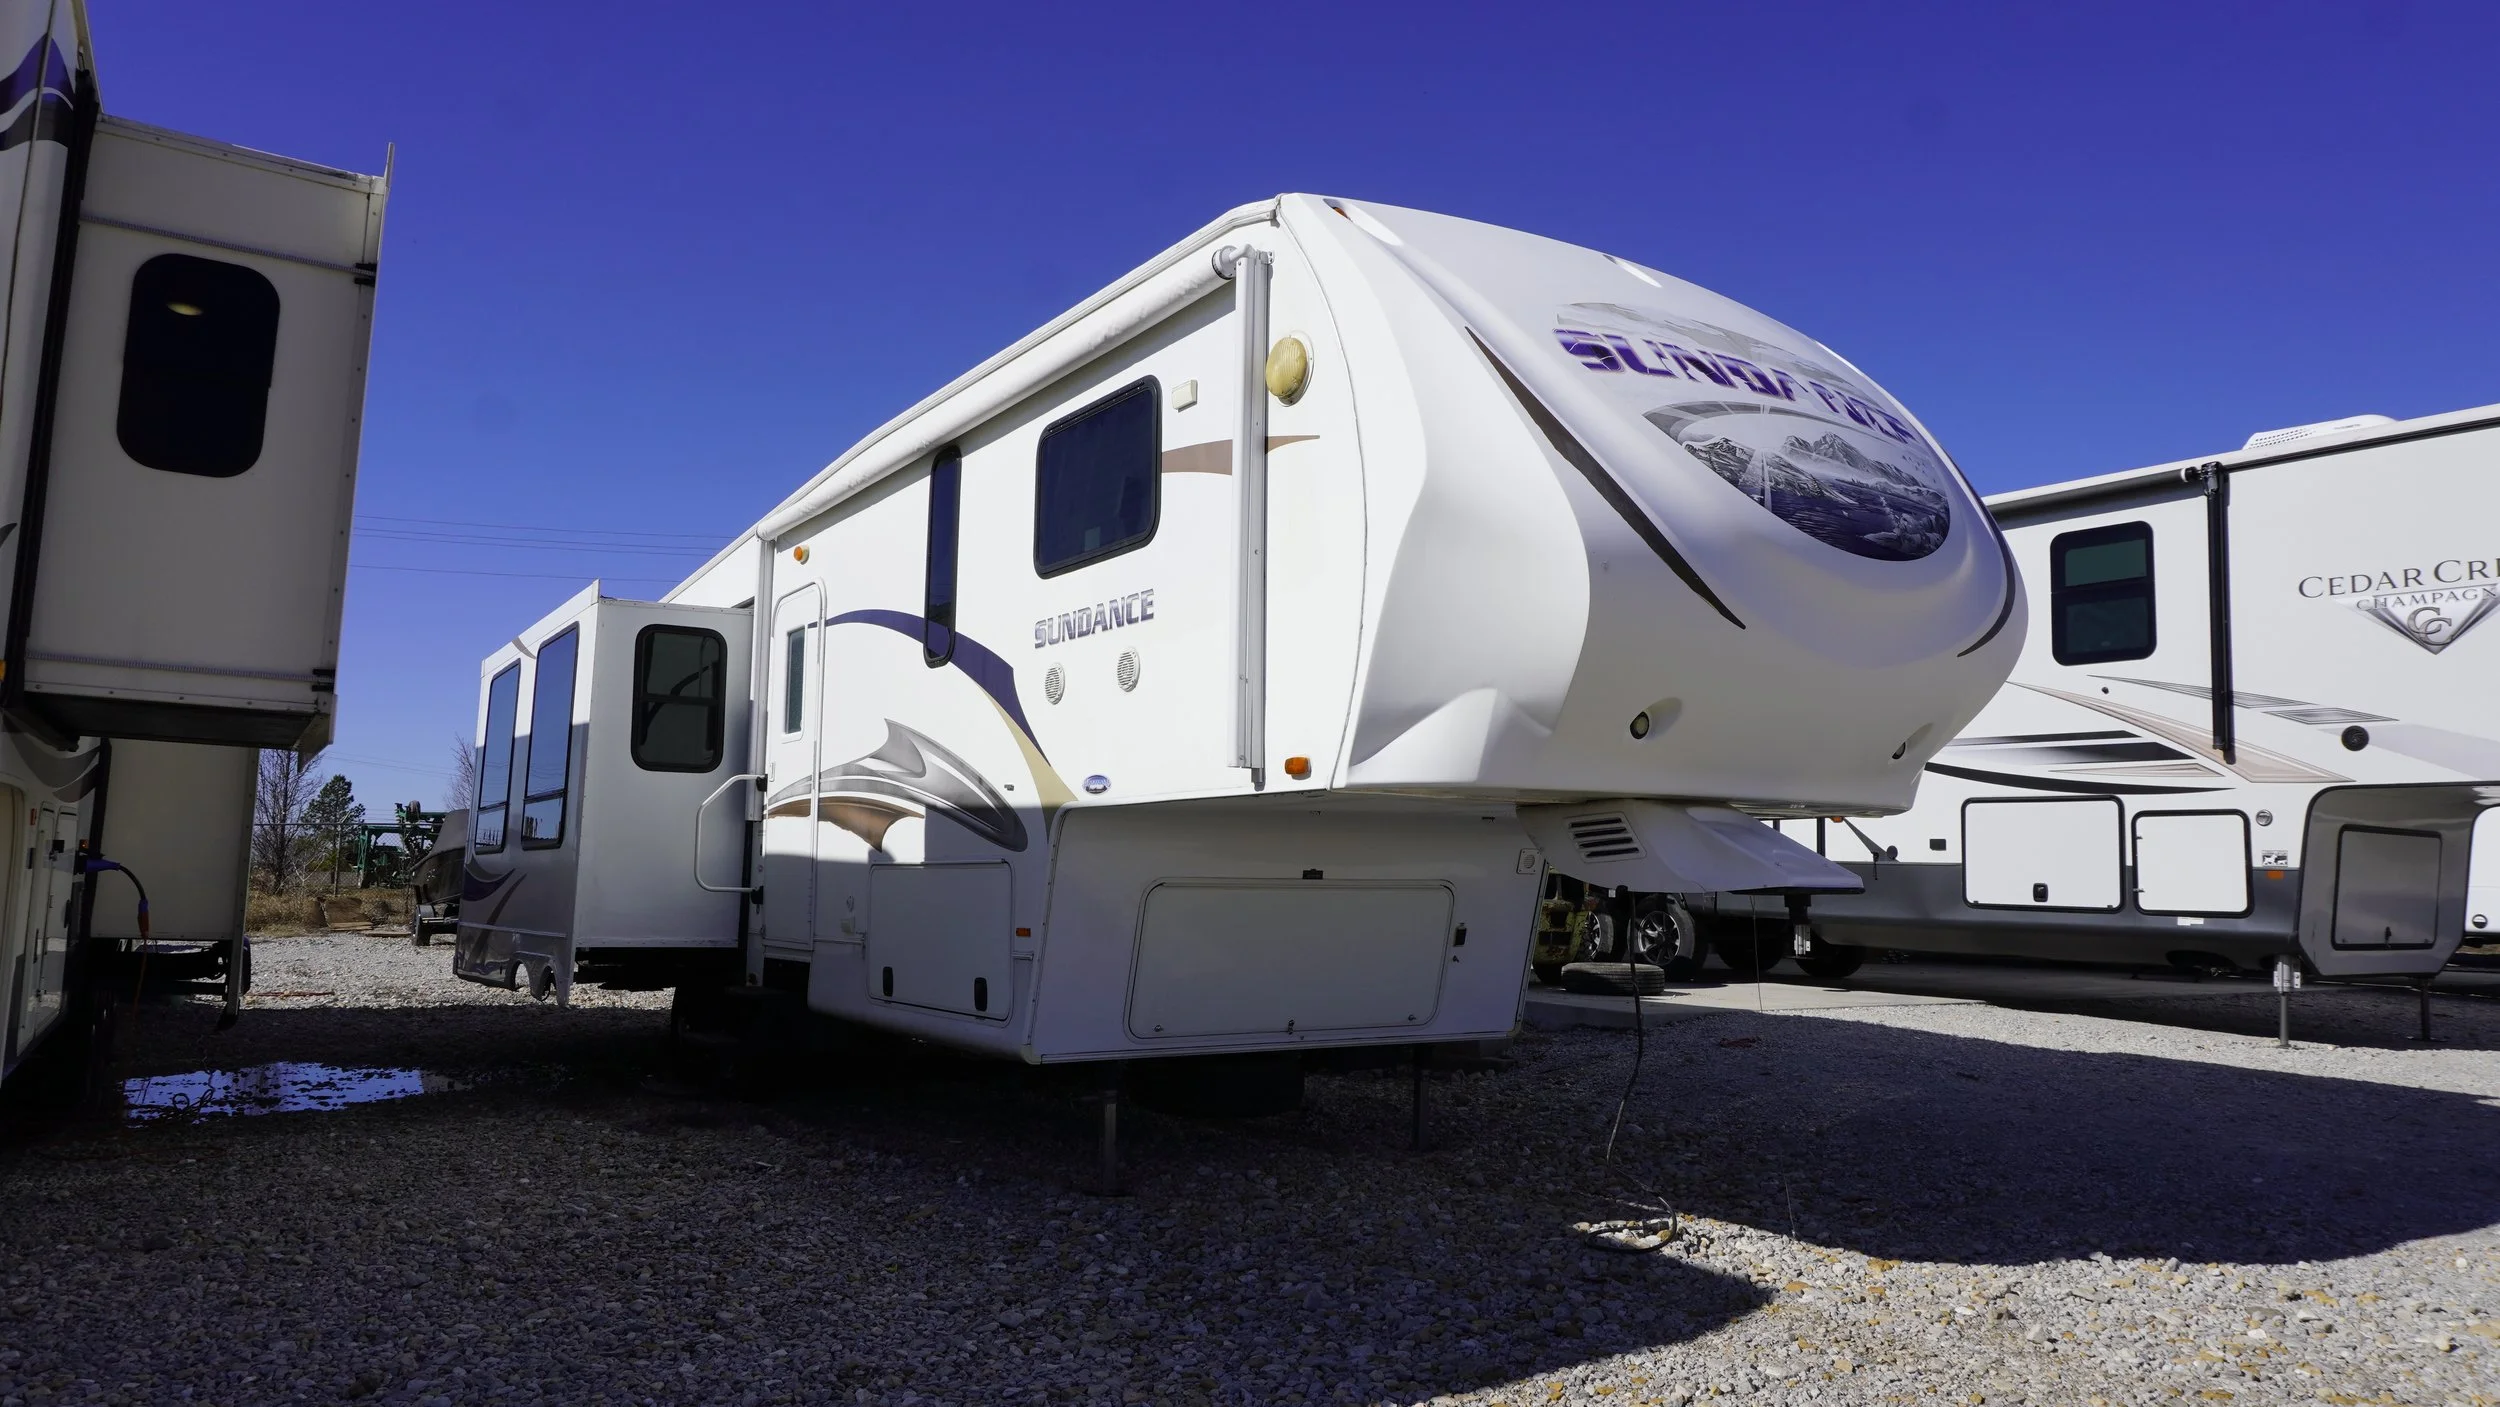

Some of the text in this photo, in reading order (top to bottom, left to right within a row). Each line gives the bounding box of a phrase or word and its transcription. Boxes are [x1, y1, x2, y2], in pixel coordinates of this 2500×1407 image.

[2298, 557, 2500, 598] CEDAR CR
[1034, 588, 1155, 649] SUNDANCE
